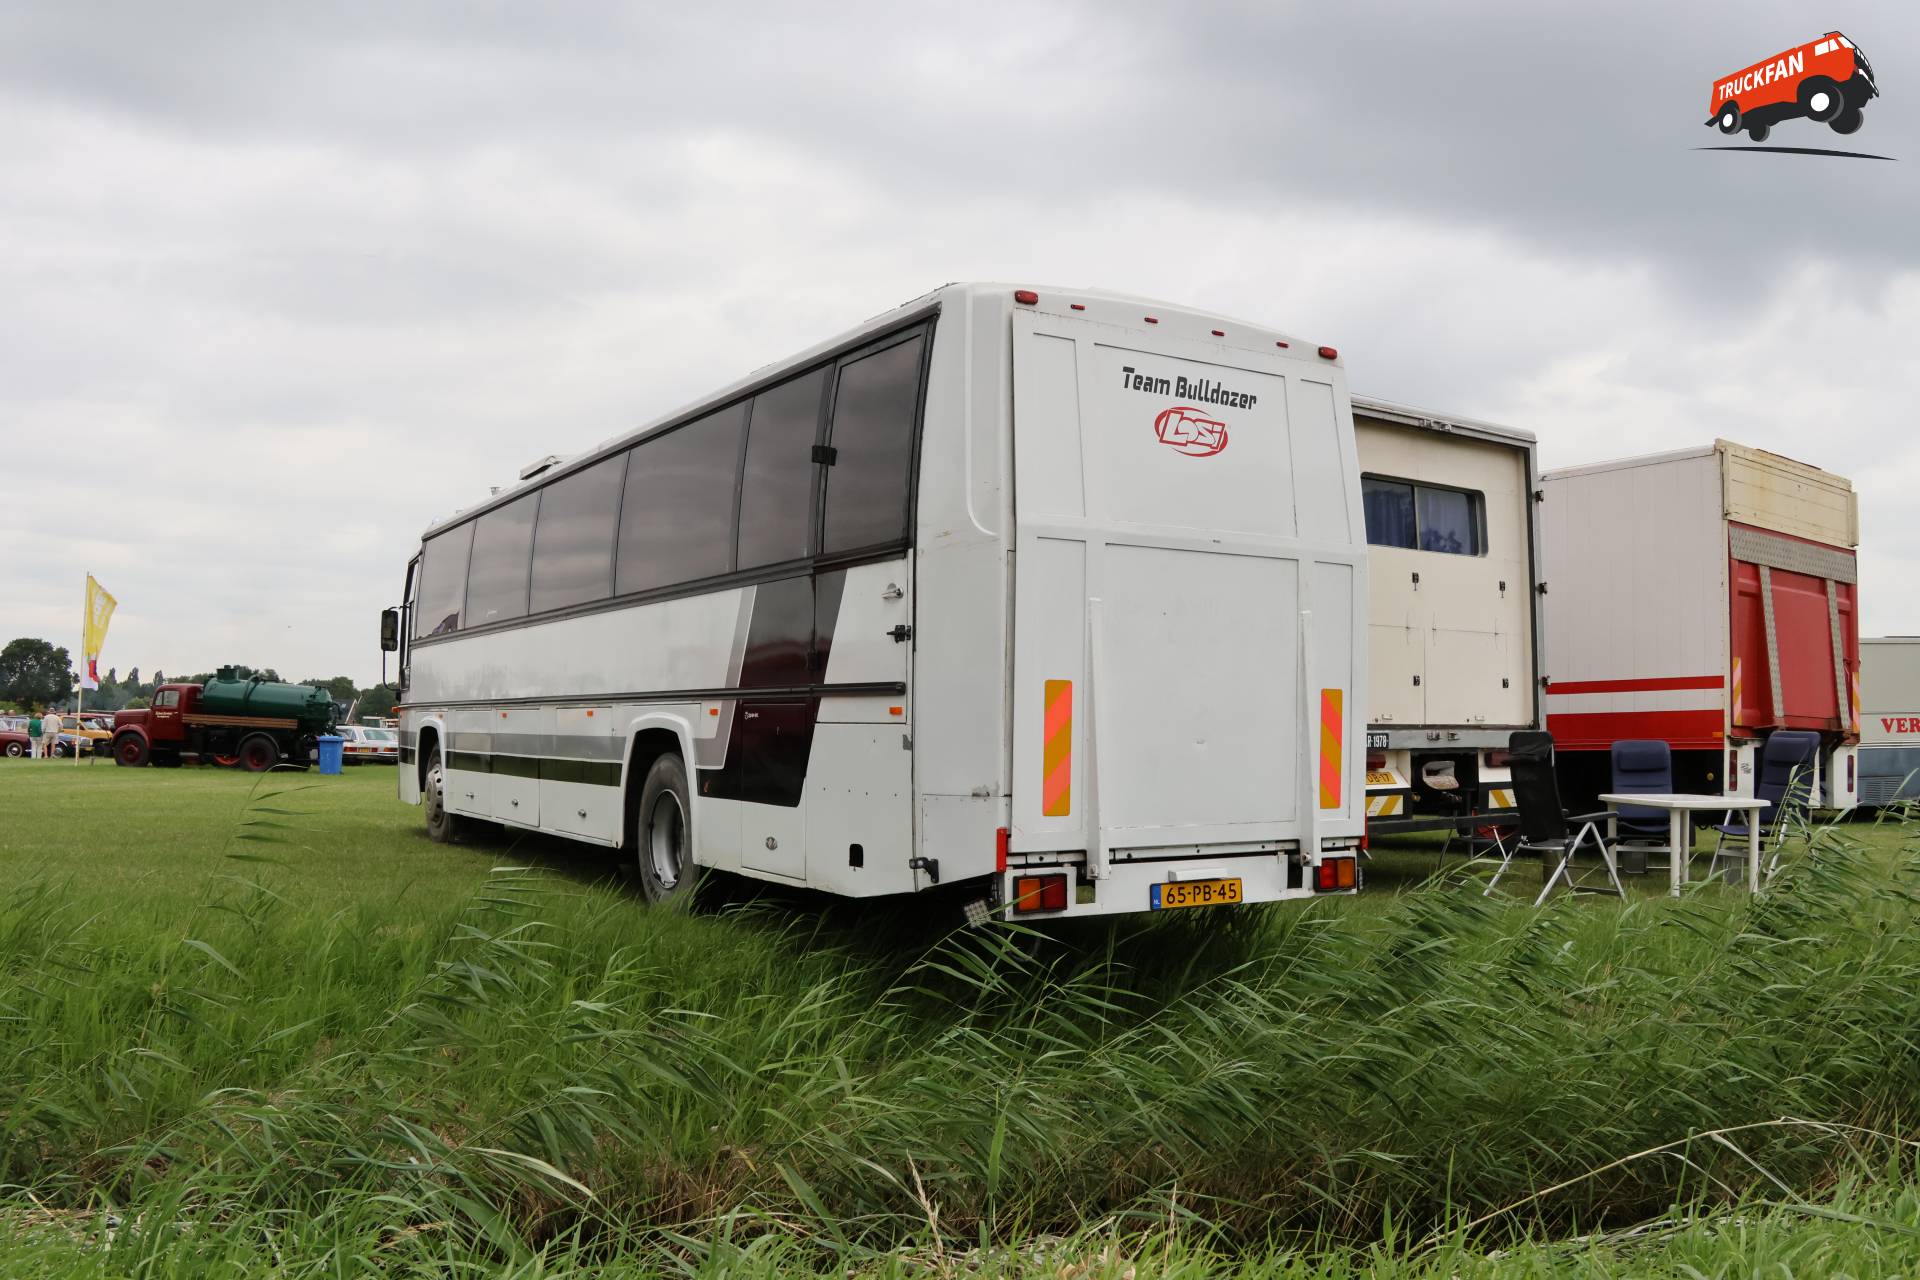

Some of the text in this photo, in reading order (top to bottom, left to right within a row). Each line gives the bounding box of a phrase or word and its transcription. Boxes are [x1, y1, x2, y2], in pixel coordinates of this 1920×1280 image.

[1122, 366, 1257, 410] Team Bulldozer
[1166, 882, 1237, 905] 65-PB-45
